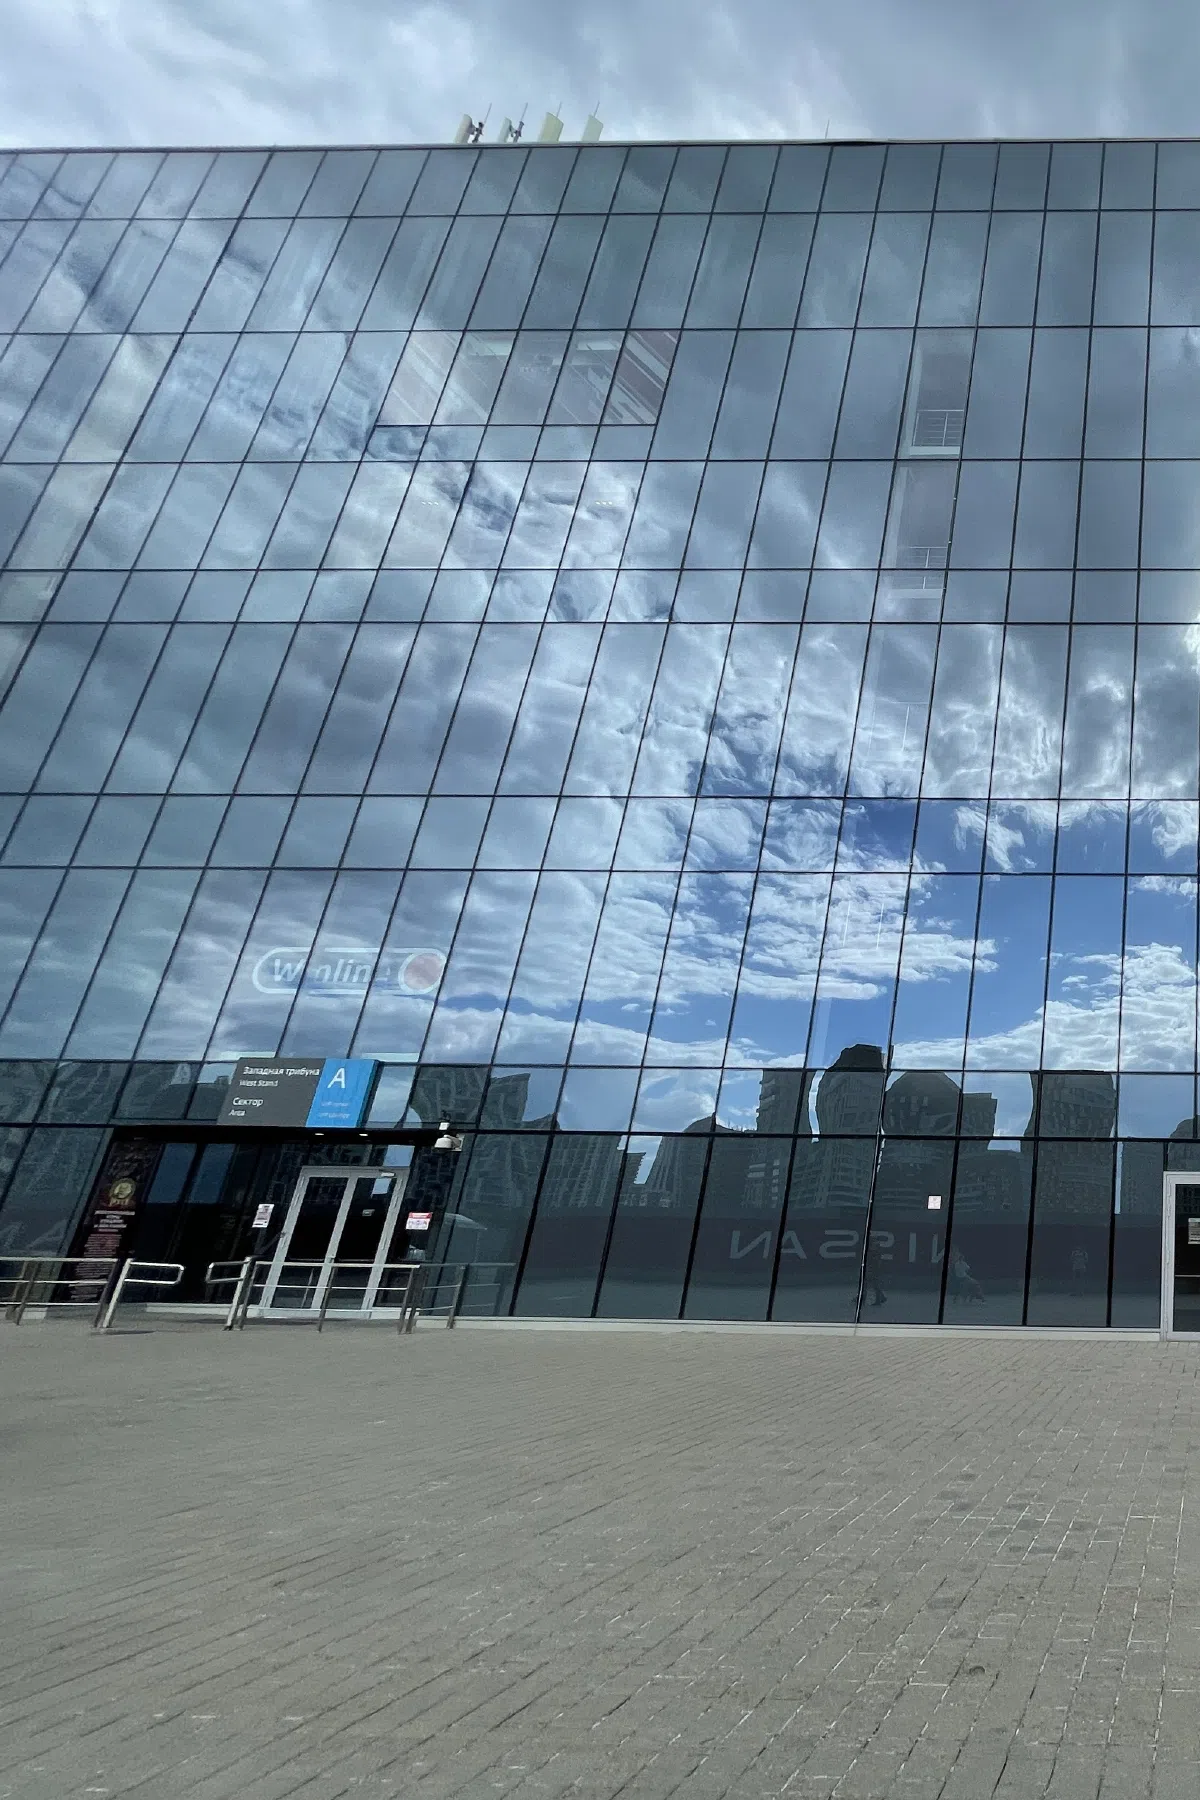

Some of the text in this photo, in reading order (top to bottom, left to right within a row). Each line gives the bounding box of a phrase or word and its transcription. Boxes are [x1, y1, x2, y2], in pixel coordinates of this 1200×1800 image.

[273, 958, 392, 984] Wnlin
[242, 1066, 320, 1077] Западная трибуна
[239, 1079, 257, 1087] West
[232, 1097, 264, 1107] Сектор
[228, 1109, 246, 1117] Area
